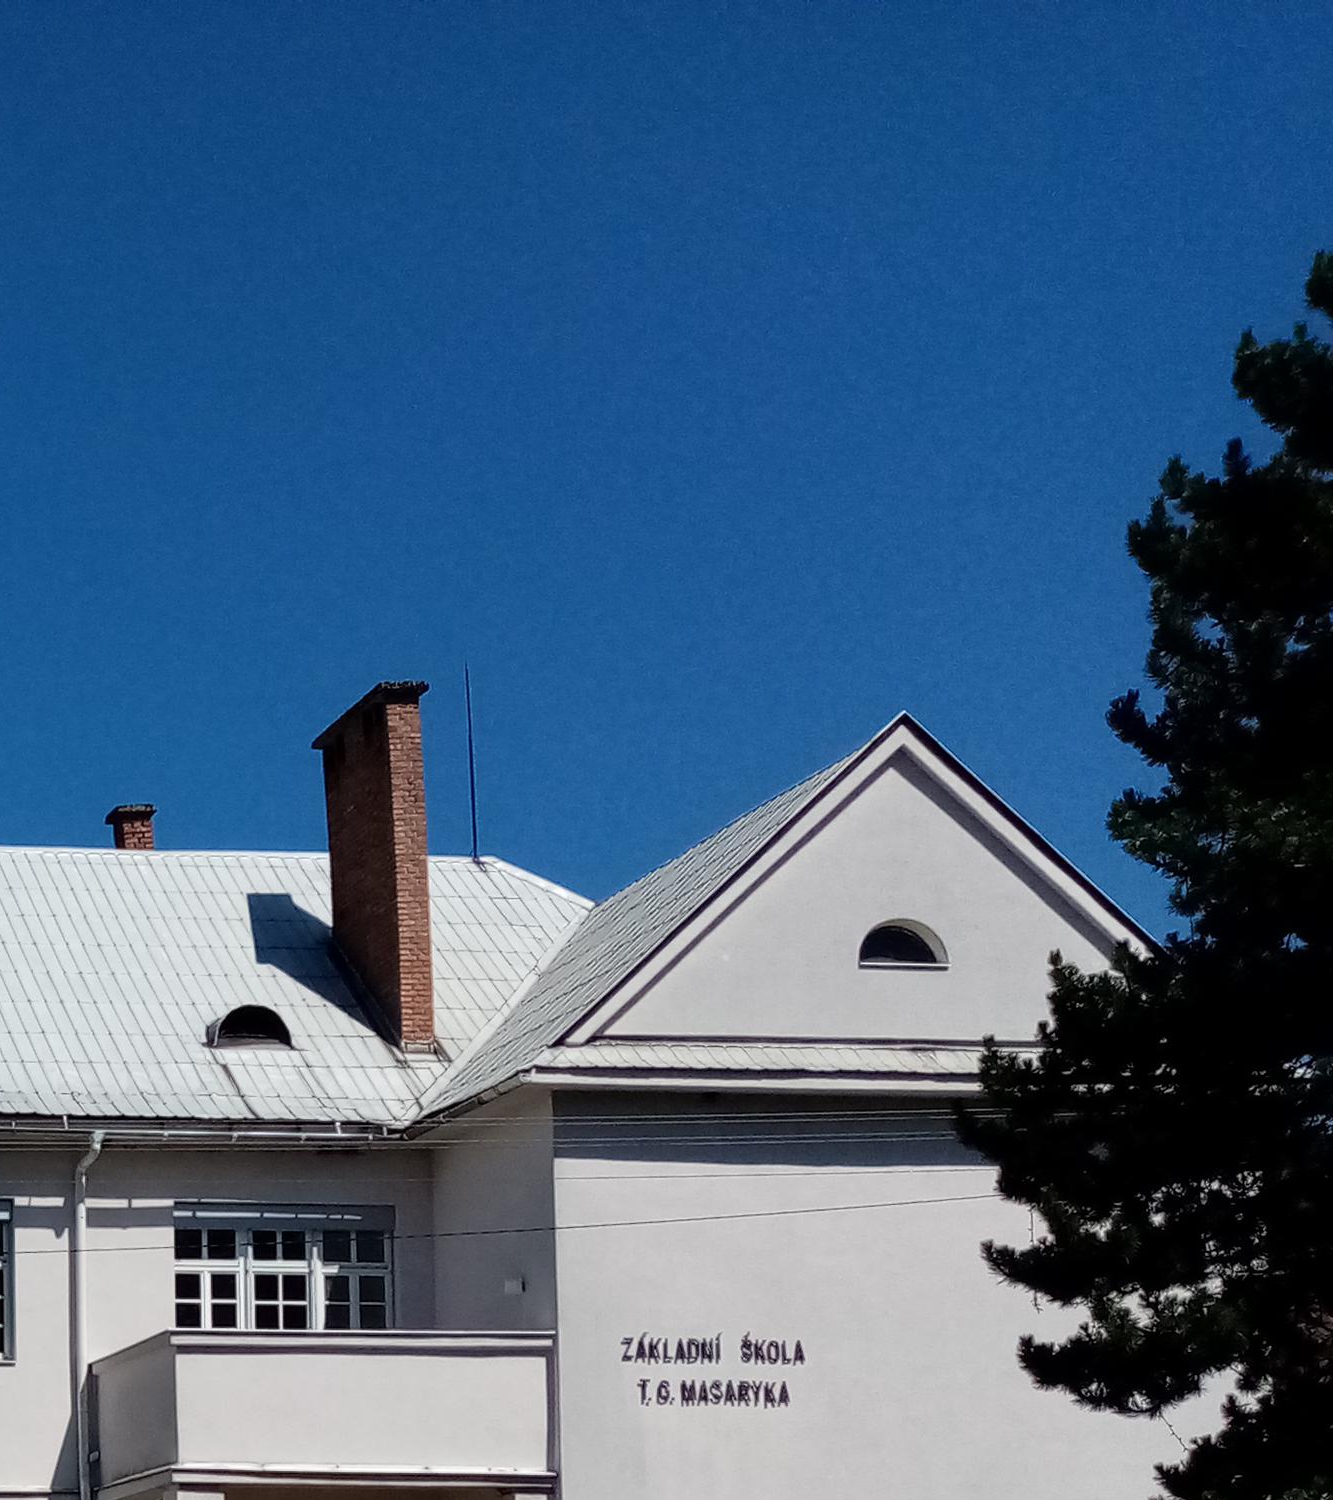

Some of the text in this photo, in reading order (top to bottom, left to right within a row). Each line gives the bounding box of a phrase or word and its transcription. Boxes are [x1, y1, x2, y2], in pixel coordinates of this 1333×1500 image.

[621, 1332, 805, 1365] ZÁKLADNÍ ŠKOLA
[680, 1380, 790, 1408] MASARYKA
